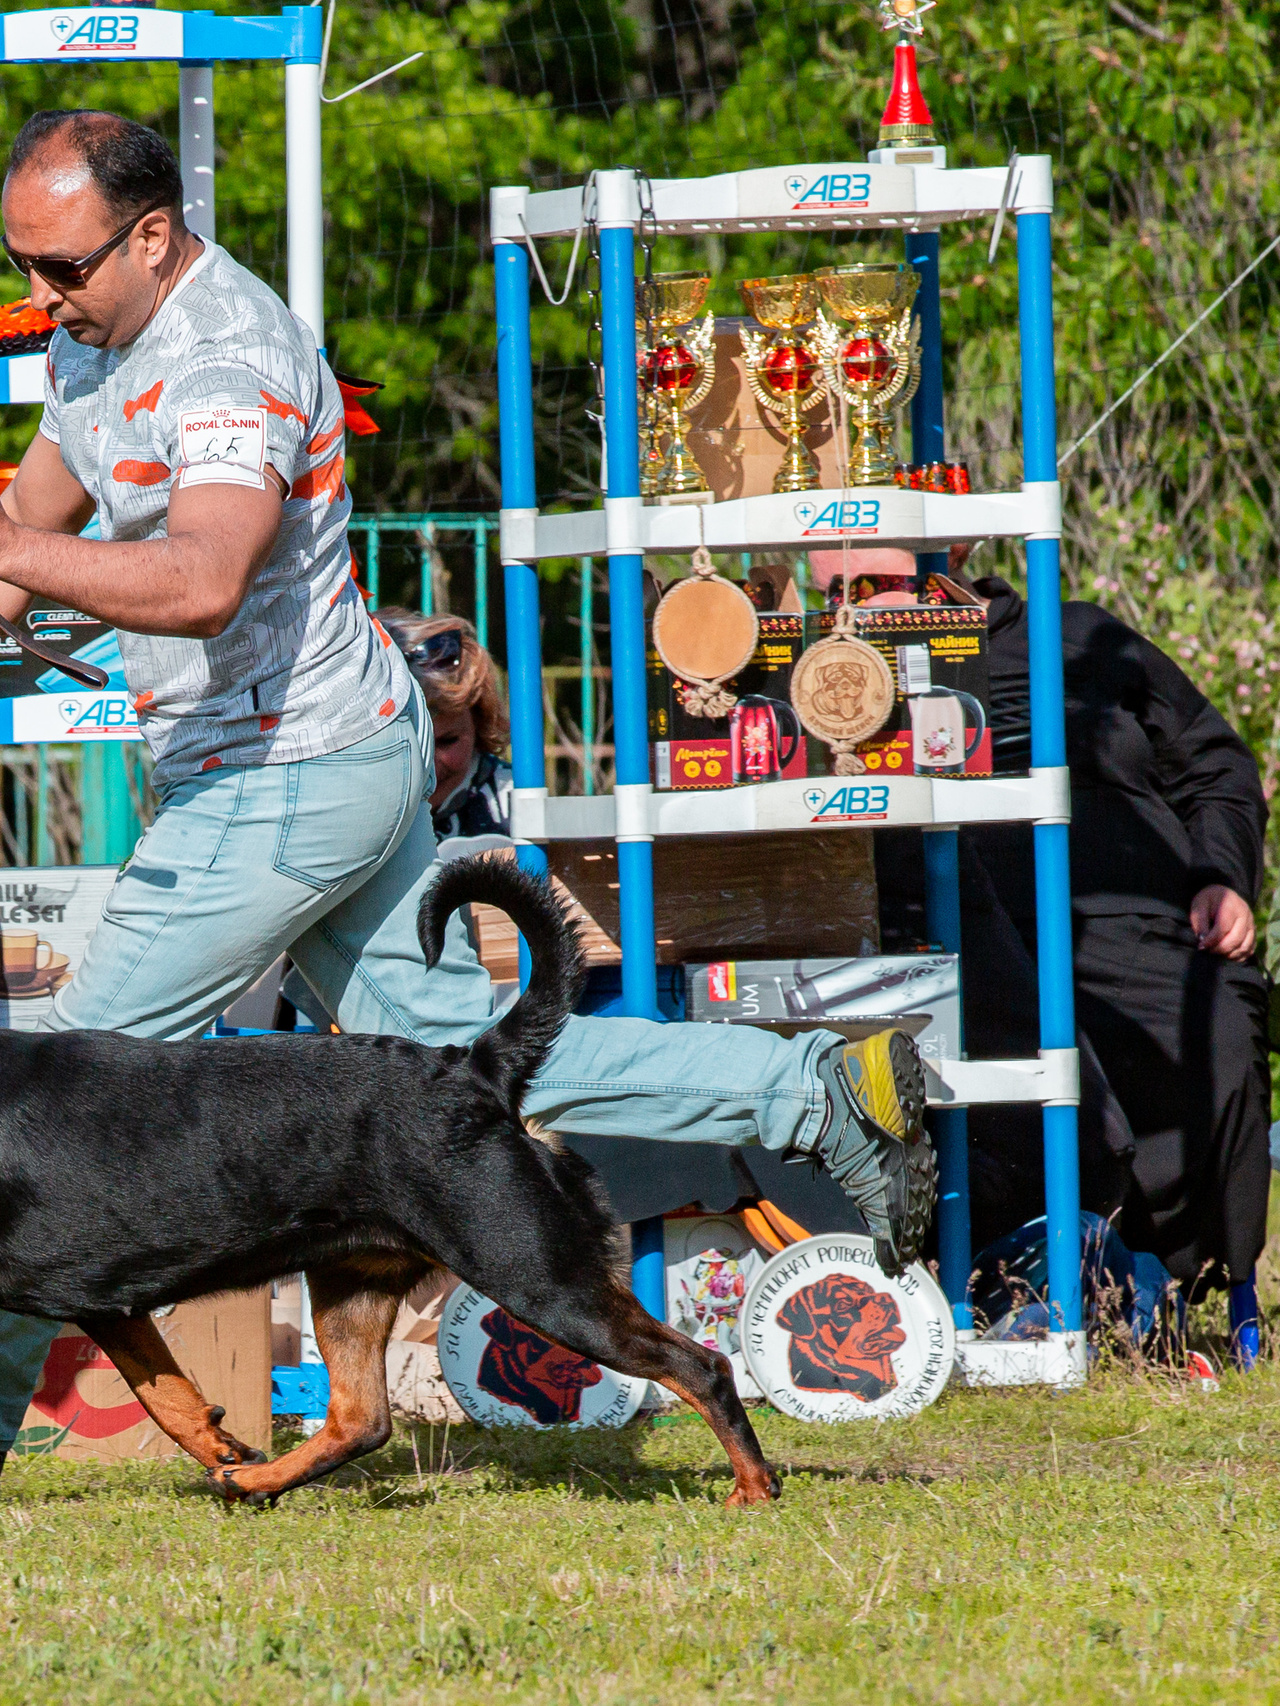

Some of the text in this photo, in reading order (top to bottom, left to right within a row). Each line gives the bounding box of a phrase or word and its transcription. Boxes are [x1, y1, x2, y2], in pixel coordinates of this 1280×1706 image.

[186, 419, 260, 432] ROYAL CANIN
[930, 635, 979, 648] ЧАЙНИК
[26, 904, 66, 923] SET
[742, 983, 760, 1017] UM
[923, 1035, 938, 1056] .9L
[817, 1245, 921, 1297] РОТВЕЙОВ
[926, 1316, 944, 1350] 2022
[614, 1381, 632, 1413] 2022
